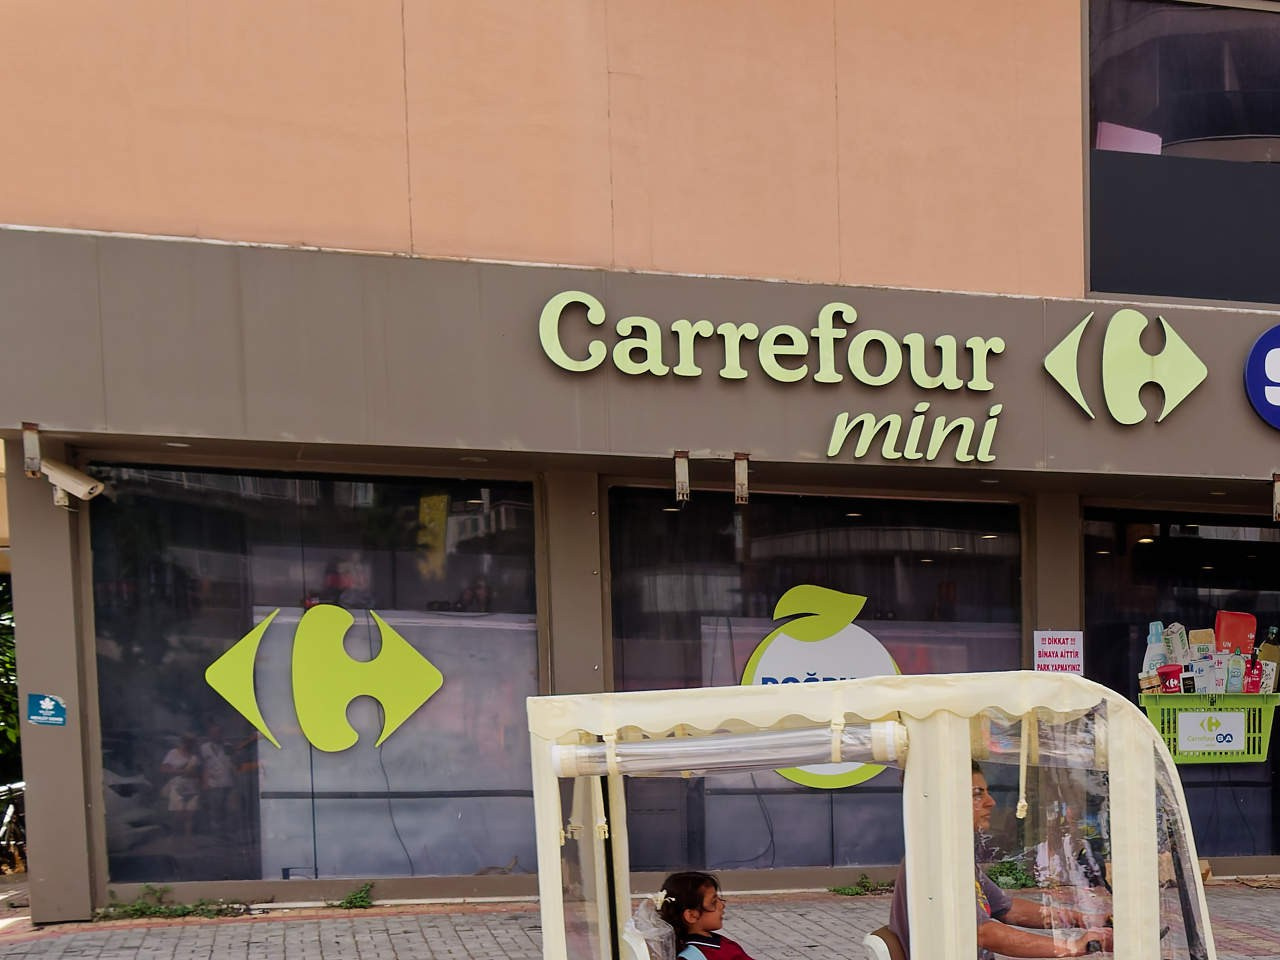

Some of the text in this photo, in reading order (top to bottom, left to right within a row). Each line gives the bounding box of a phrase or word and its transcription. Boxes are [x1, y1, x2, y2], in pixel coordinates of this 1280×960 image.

[538, 290, 1006, 392] Carrefour
[827, 401, 1004, 463] mini
[1036, 663, 1050, 672] PARK
